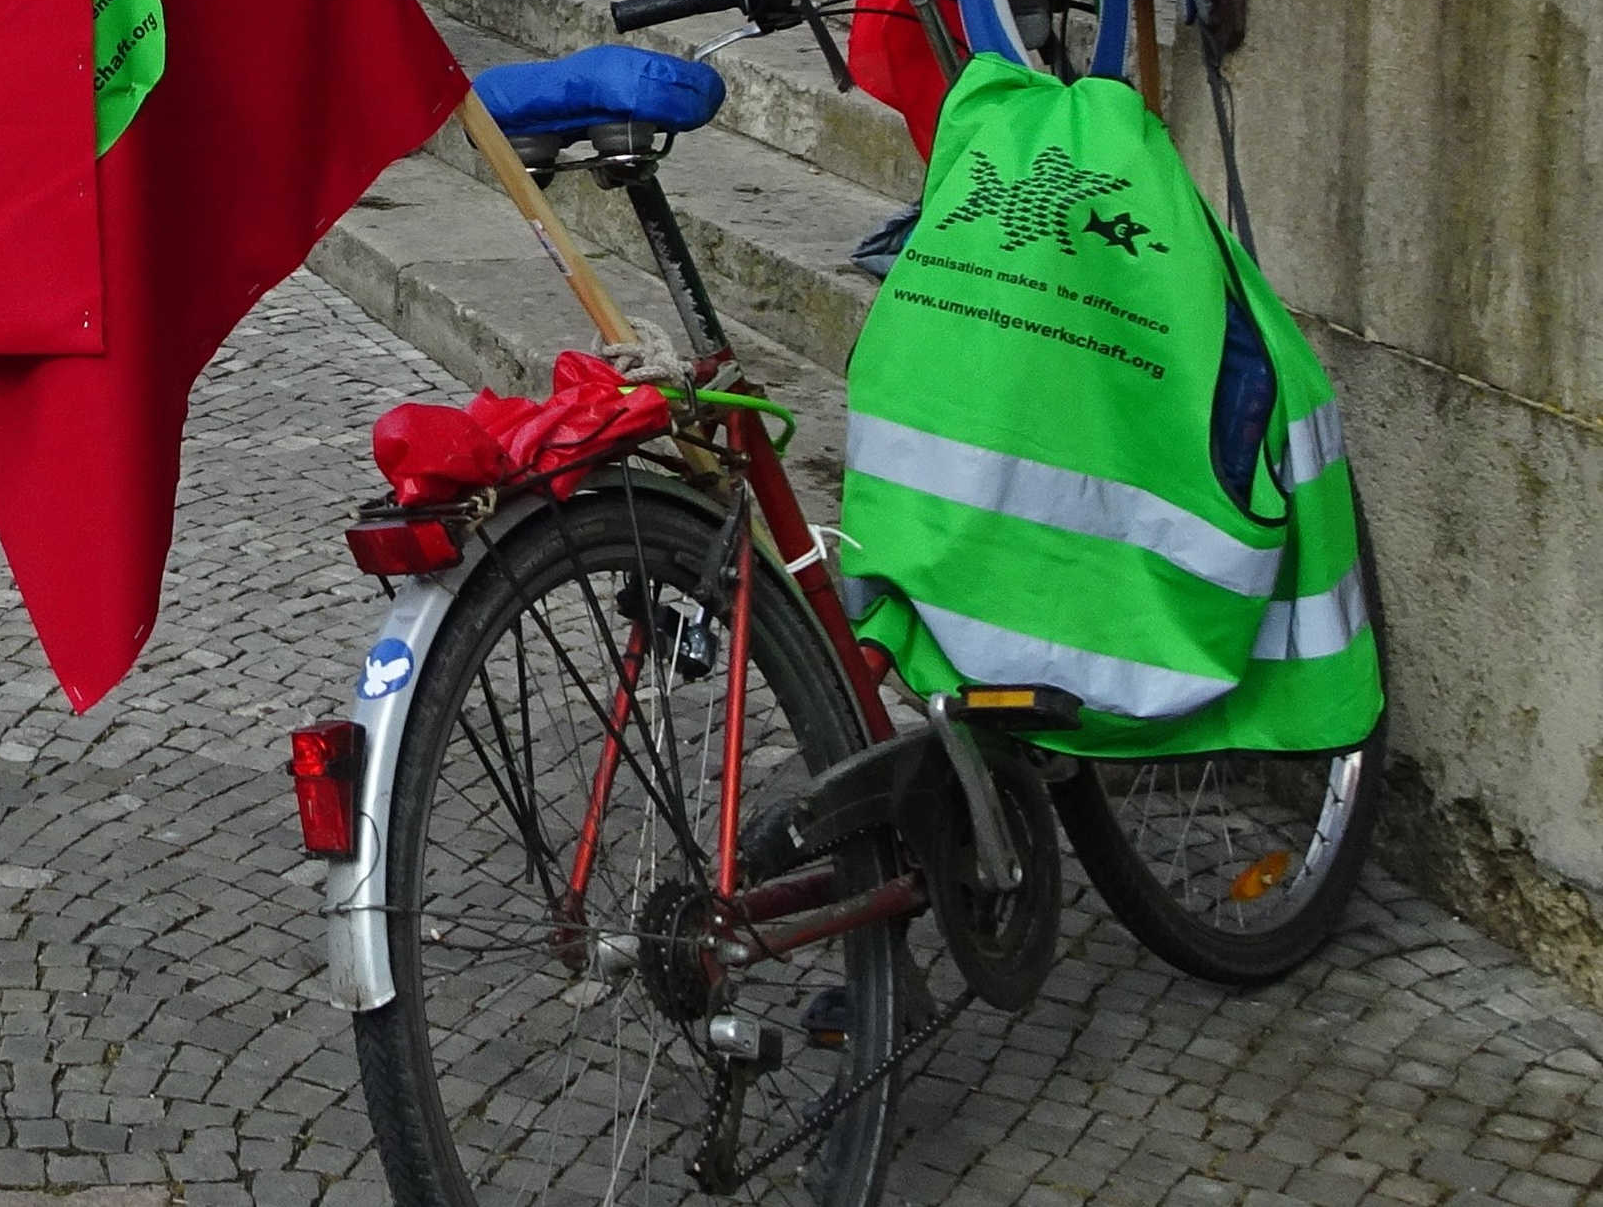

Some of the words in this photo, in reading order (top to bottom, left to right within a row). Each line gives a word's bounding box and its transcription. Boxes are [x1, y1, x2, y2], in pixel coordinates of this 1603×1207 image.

[893, 287, 1166, 380] www.umweltgewerkschaft.org
[905, 248, 993, 279] Organisation
[997, 272, 1048, 292] makes
[1056, 284, 1079, 301] the
[1083, 294, 1170, 335] difference
